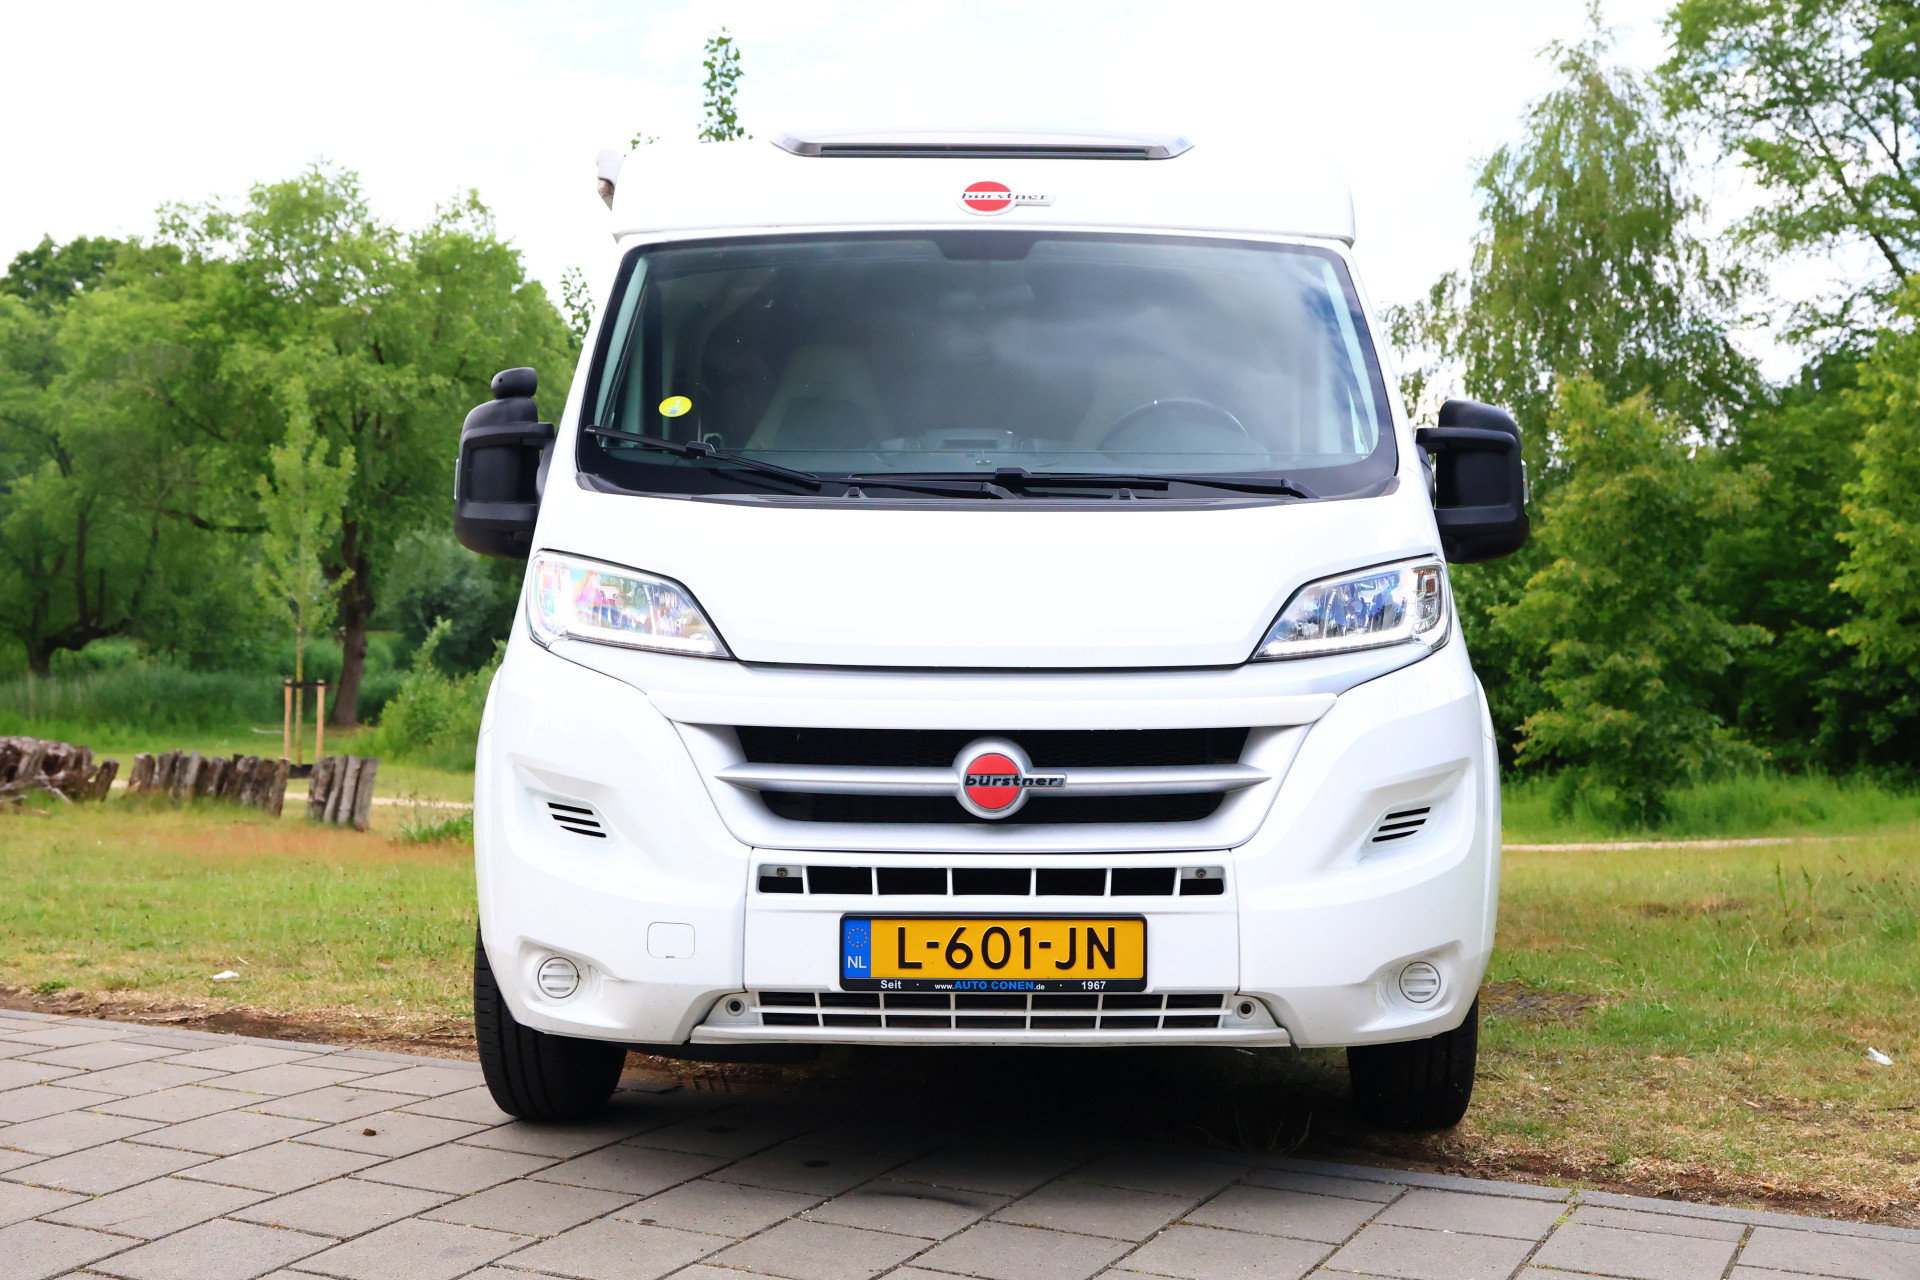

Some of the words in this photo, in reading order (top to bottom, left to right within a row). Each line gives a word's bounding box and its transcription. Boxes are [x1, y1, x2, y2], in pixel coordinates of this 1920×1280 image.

[964, 775, 1058, 786] bürstner
[898, 926, 1116, 970] L-601-JN
[847, 955, 867, 969] NL
[880, 979, 902, 989] Seit
[1081, 981, 1107, 990] 1967
